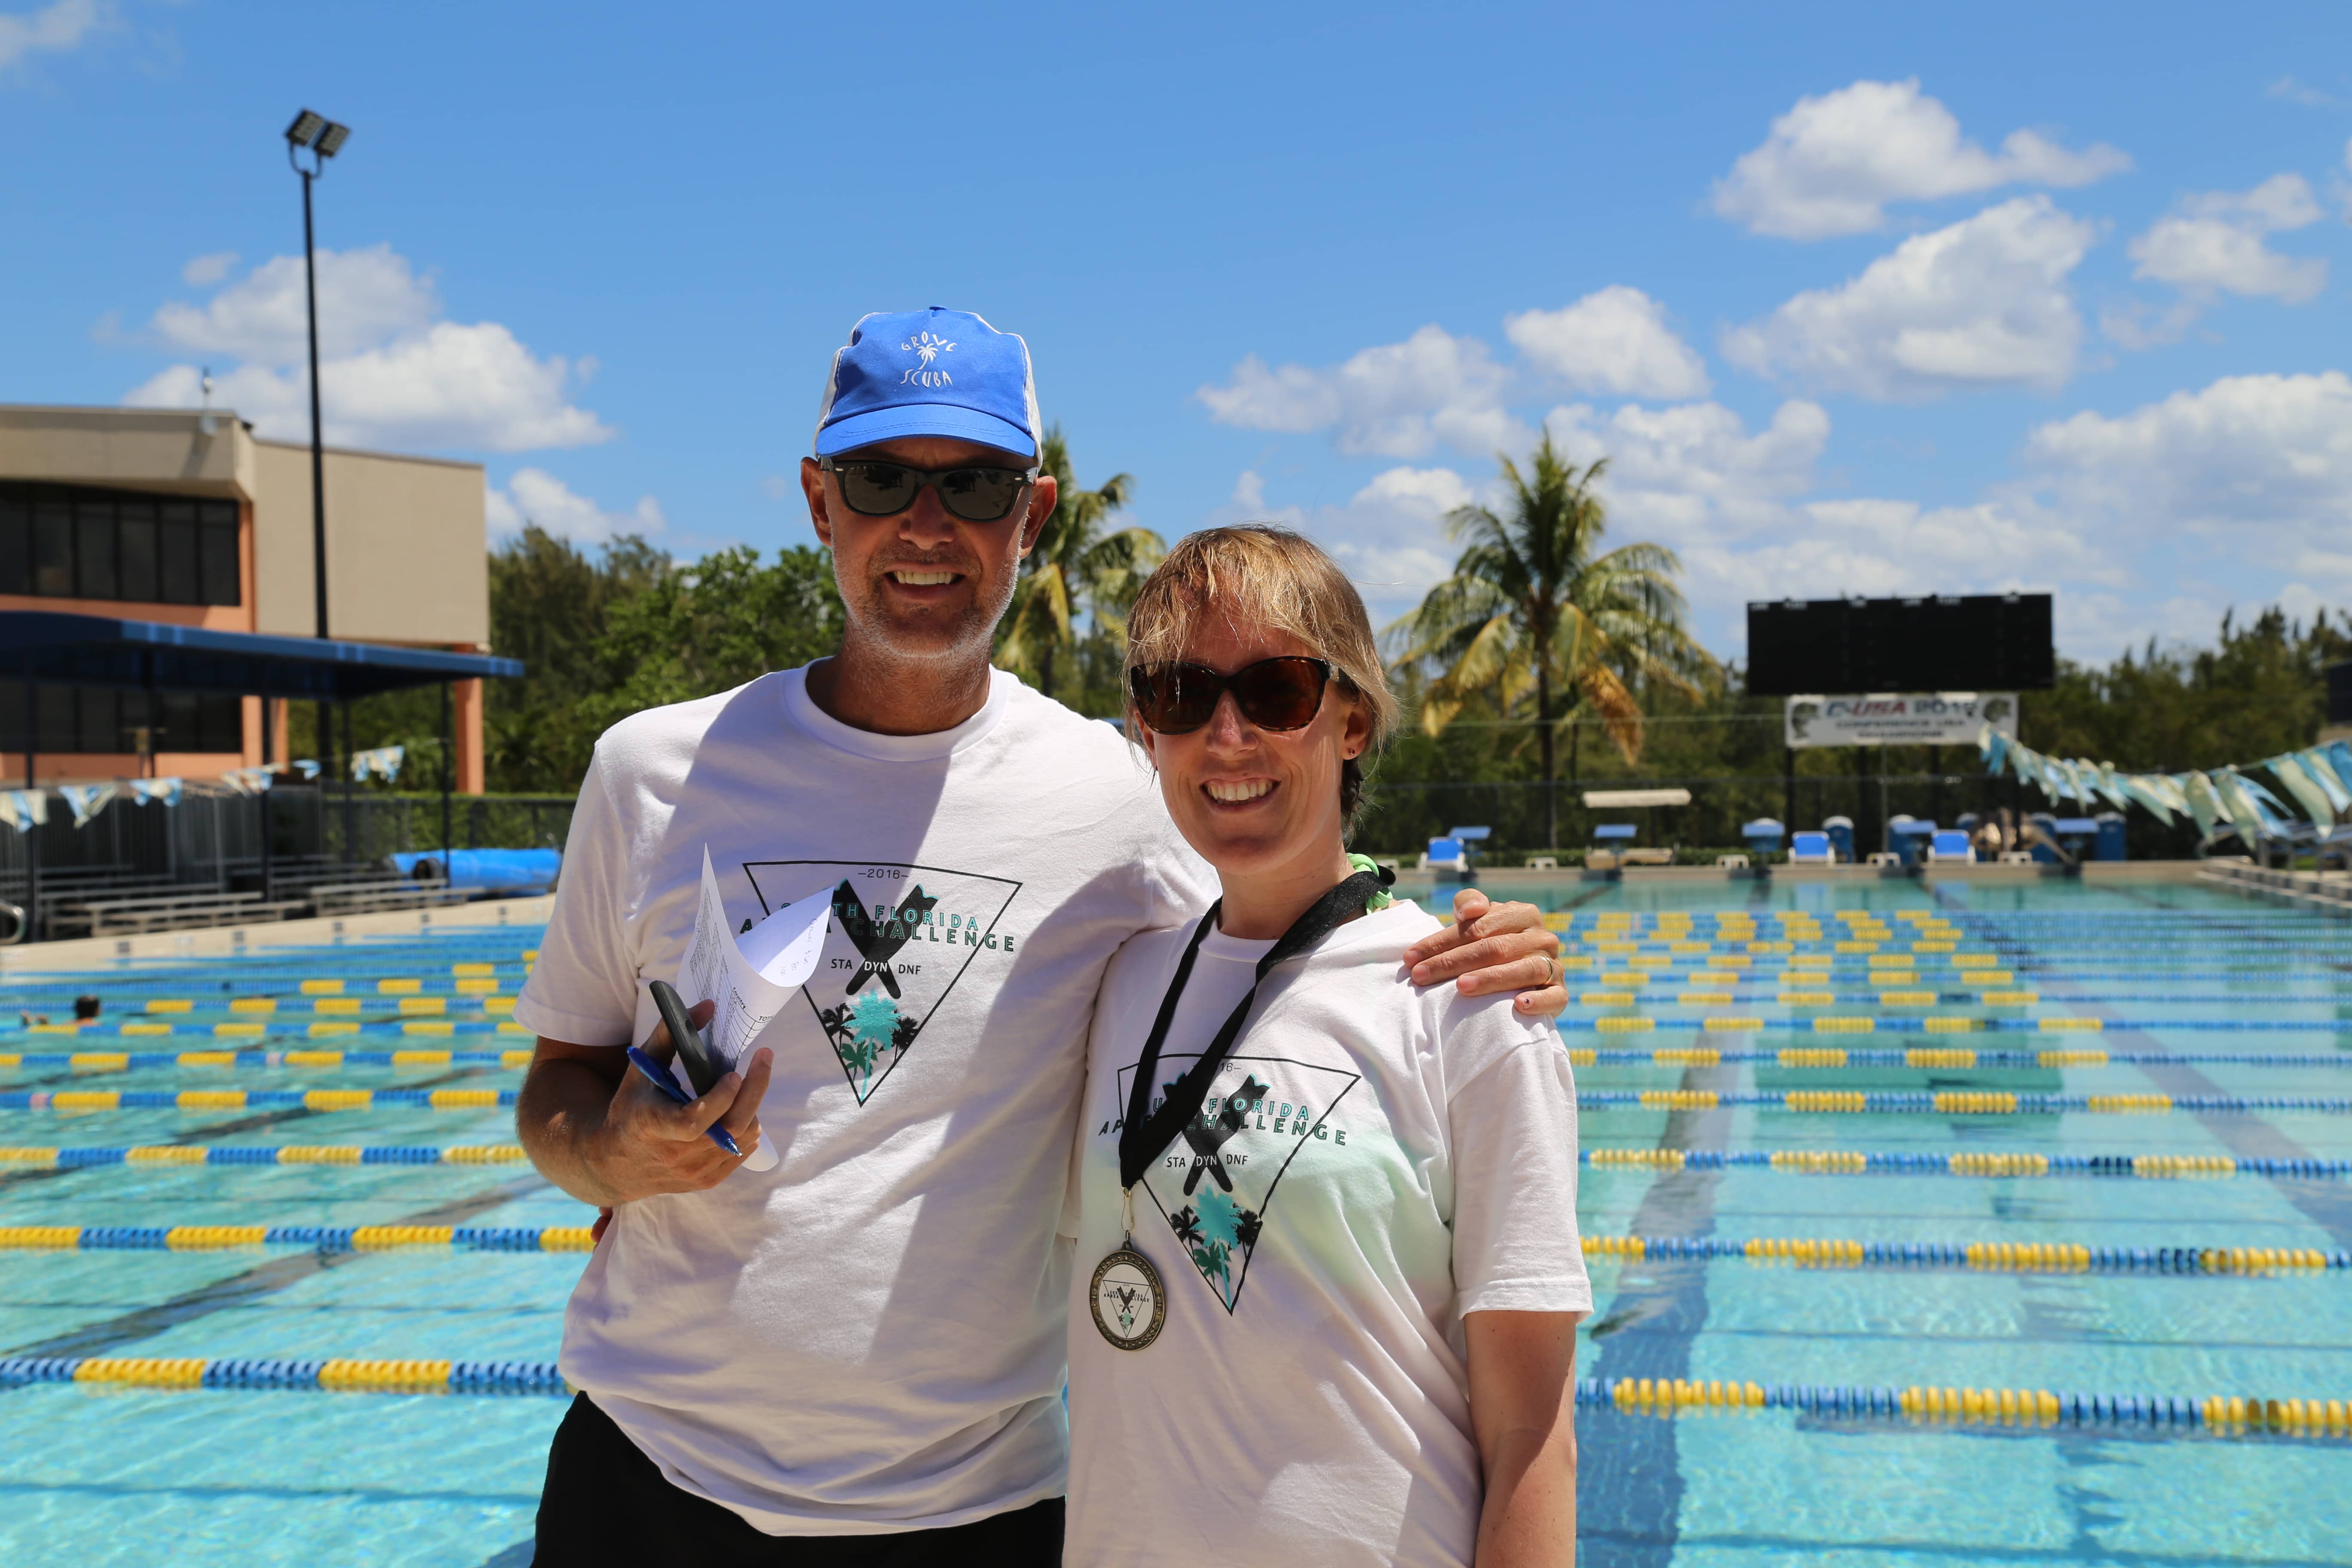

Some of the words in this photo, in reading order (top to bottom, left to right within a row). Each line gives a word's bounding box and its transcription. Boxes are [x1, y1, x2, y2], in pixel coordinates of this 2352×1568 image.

[901, 331, 958, 351] GROVE
[900, 369, 953, 388] SCUBA
[875, 904, 979, 931] FLORIDA
[851, 919, 1014, 952] CHALLENGE
[830, 958, 853, 970] STA
[864, 961, 888, 973] DYN
[898, 963, 922, 975] DNF
[733, 987, 746, 1009] Country
[1208, 1098, 1309, 1120] FLORIDA
[1167, 1157, 1185, 1167] STA
[1196, 1155, 1217, 1167] DYN
[1226, 1154, 1248, 1165] DNF
